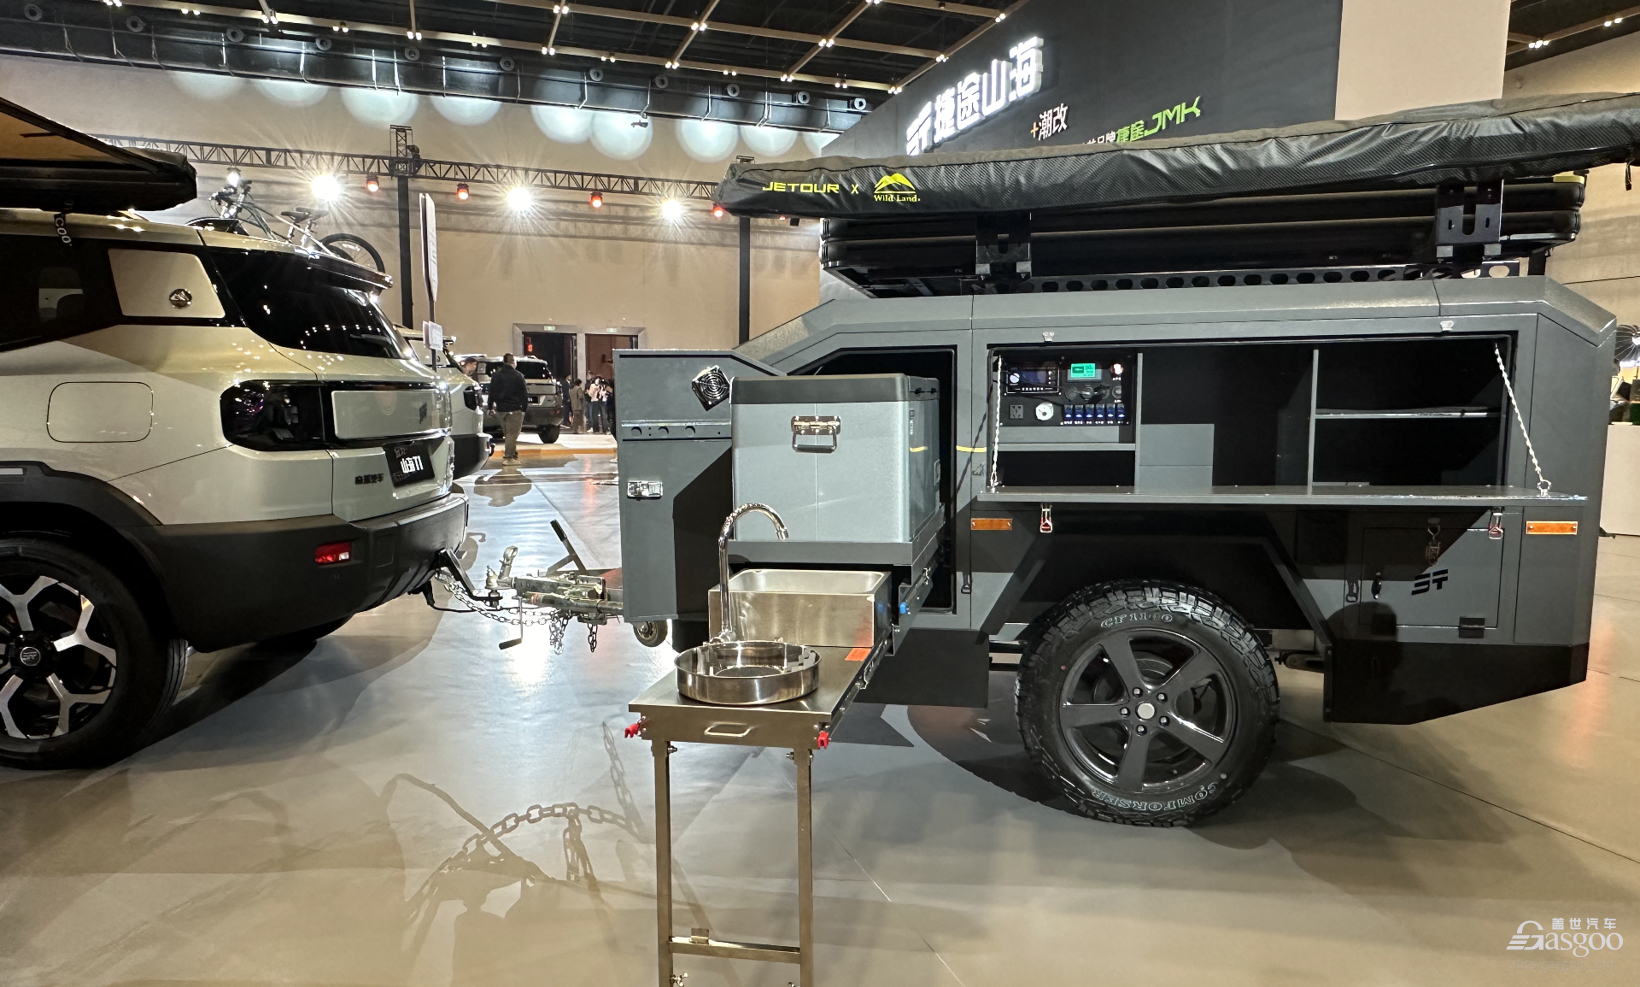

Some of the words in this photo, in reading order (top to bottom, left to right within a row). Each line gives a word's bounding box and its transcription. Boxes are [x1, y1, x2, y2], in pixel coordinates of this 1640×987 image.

[762, 181, 840, 194] JETOUR
[873, 194, 894, 203] Wild
[896, 194, 918, 203] Land
